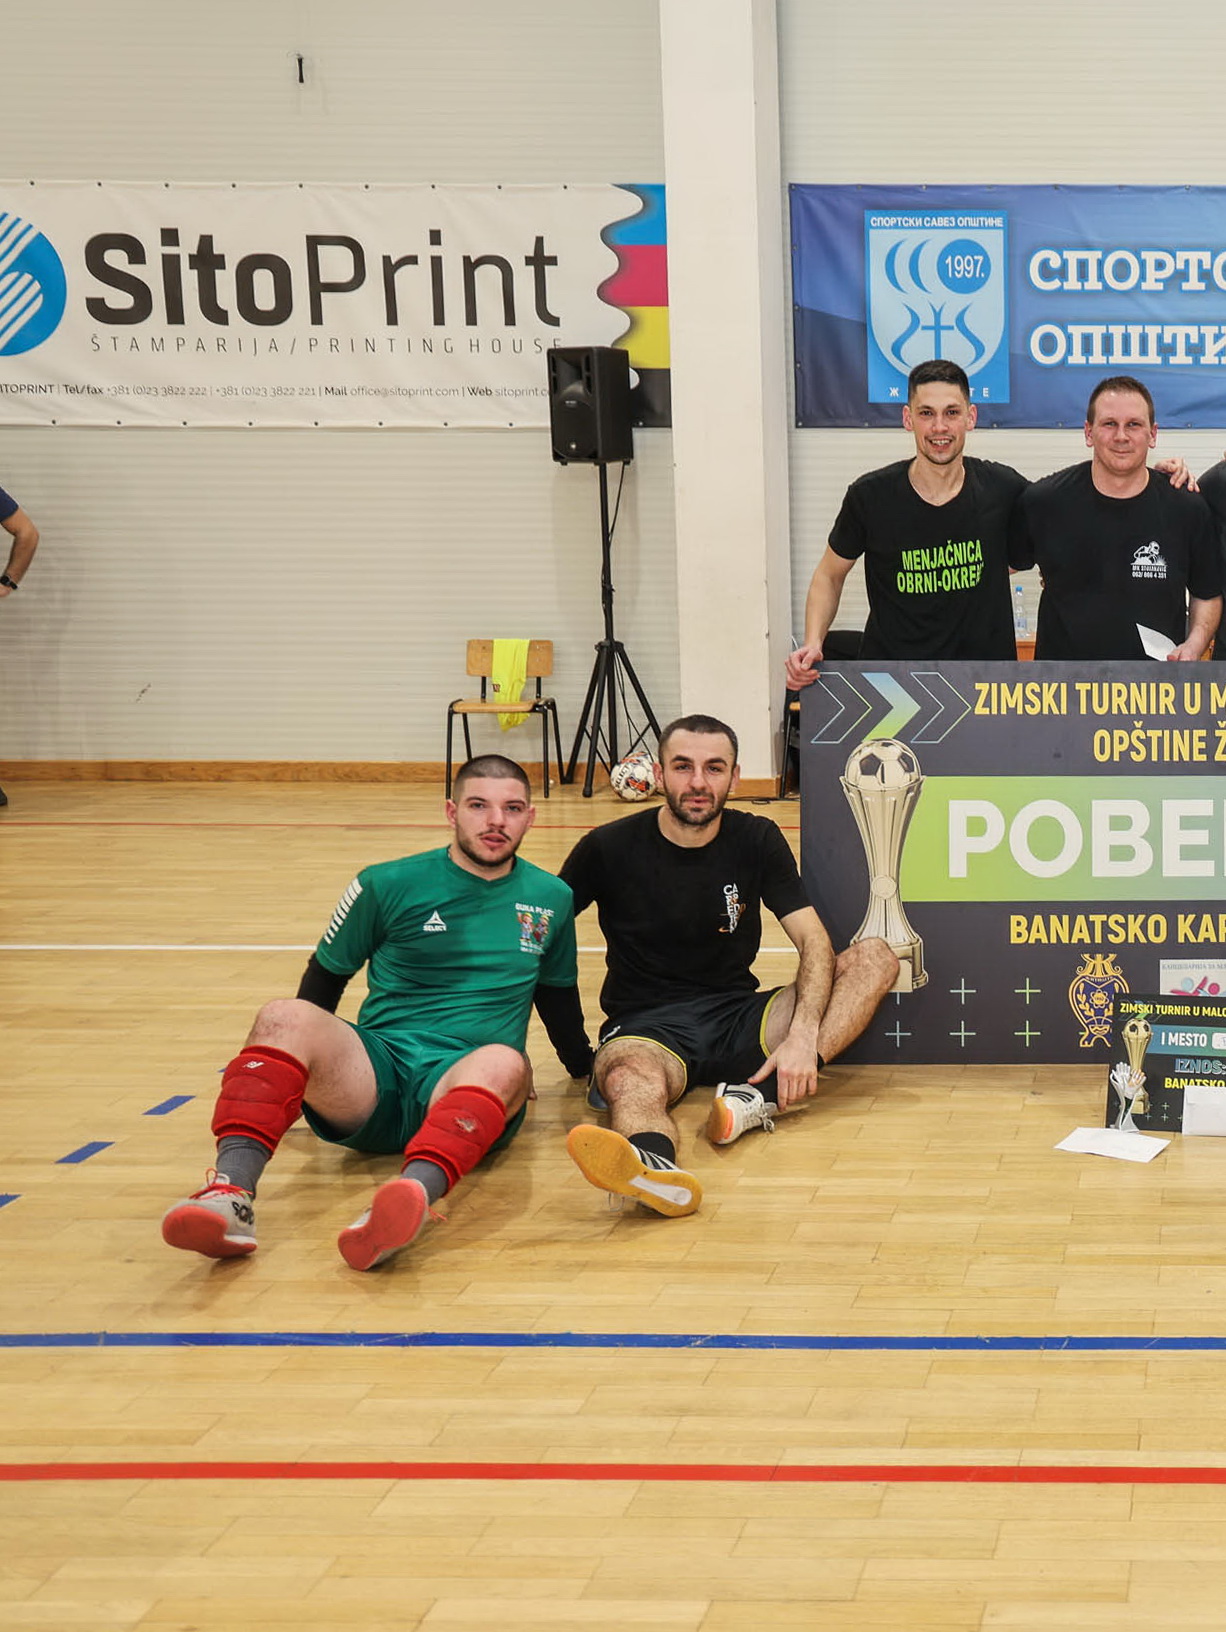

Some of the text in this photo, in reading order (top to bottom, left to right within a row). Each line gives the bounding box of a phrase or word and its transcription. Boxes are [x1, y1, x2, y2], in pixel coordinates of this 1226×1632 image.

[870, 216, 1004, 227] СПОРТСКИ САВЕЗ ОПШТИНЕ
[84, 228, 562, 328] SitoPrint
[945, 255, 985, 278] 1997.
[0, 384, 54, 394] ITOPRINT
[62, 384, 104, 395] Tel/fax
[324, 386, 348, 396] Mail
[467, 386, 493, 396] Web
[495, 386, 549, 398] sitoprint.c
[902, 539, 983, 571] MENJAČNICA
[974, 682, 1067, 716] ZIMSKI
[1075, 682, 1176, 716] TURNIR
[1184, 682, 1201, 716] U
[1093, 720, 1207, 762] OPŠTINE
[1009, 914, 1168, 945] BANATSKO
[1120, 1002, 1153, 1014] ZIMSKI
[1155, 1004, 1191, 1016] TURNIR
[1192, 1006, 1200, 1016] U
[1161, 1031, 1208, 1047] I MESTO
